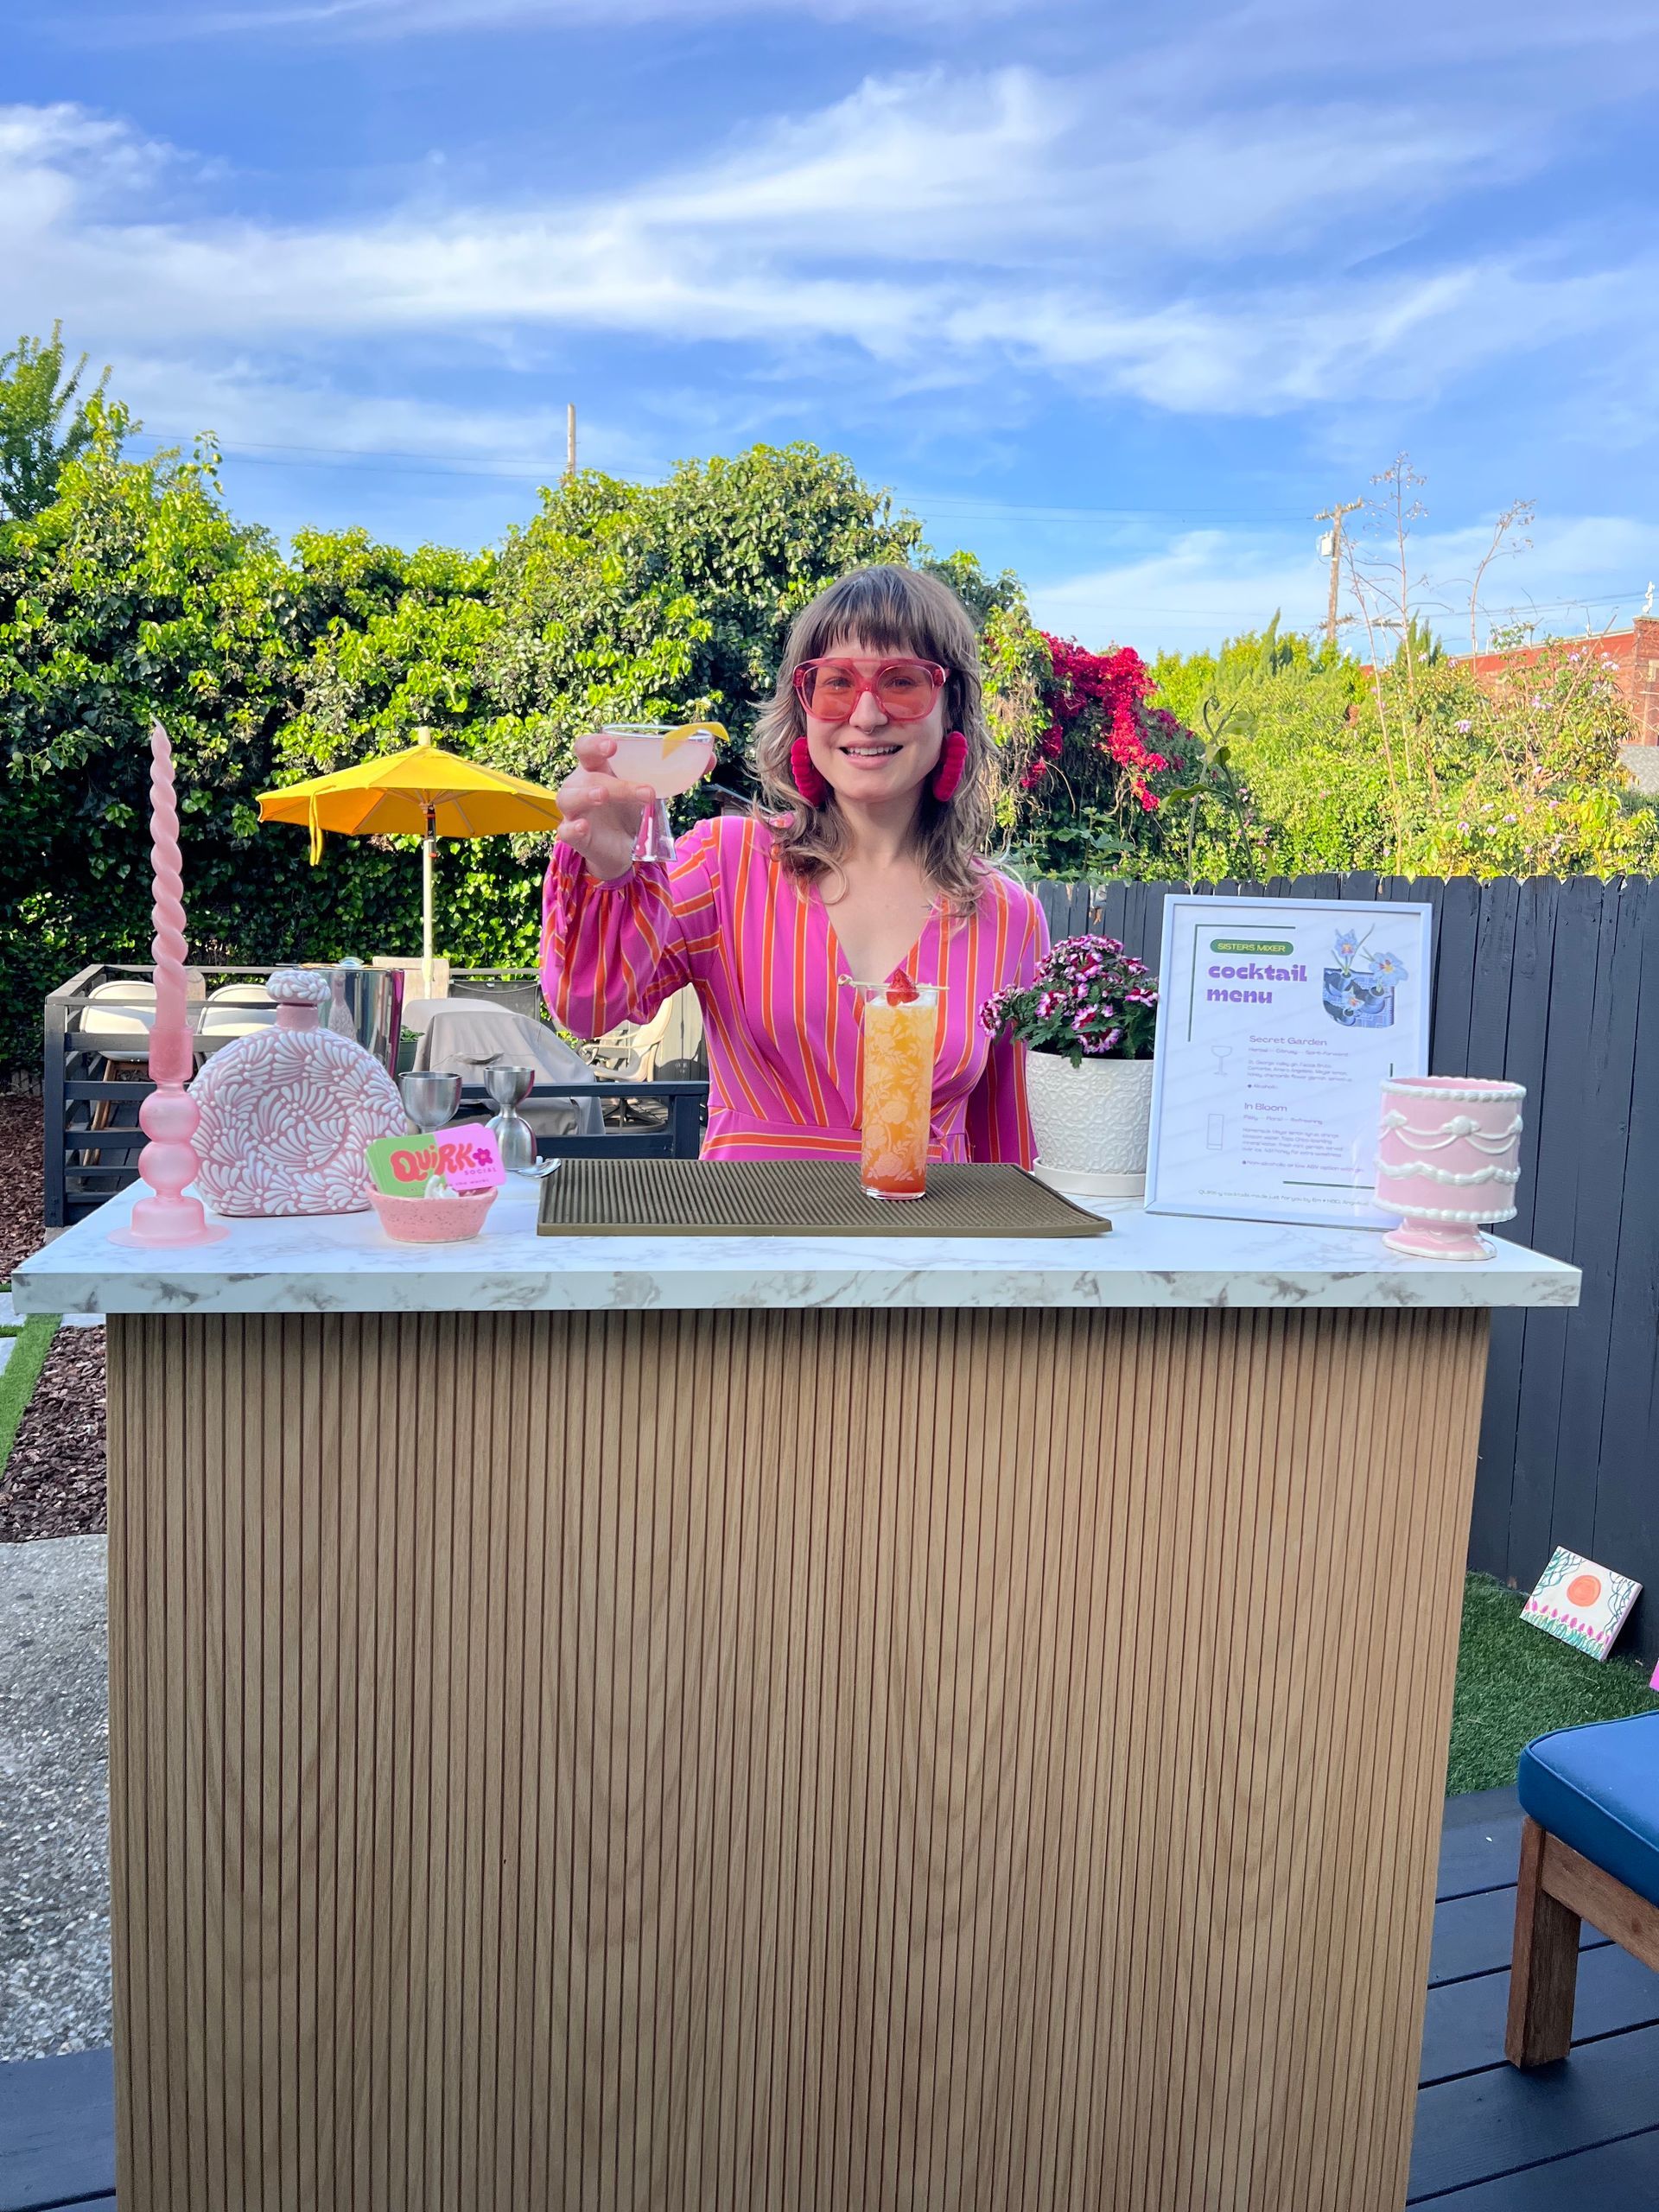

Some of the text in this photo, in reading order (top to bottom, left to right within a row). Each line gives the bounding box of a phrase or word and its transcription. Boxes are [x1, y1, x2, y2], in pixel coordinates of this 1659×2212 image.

[1217, 942, 1255, 951] SISTERS
[1208, 963, 1307, 982] cocktail
[1206, 988, 1273, 1004] menu
[1249, 1035, 1327, 1046] Secret Garden
[1255, 1103, 1287, 1112] Bloom
